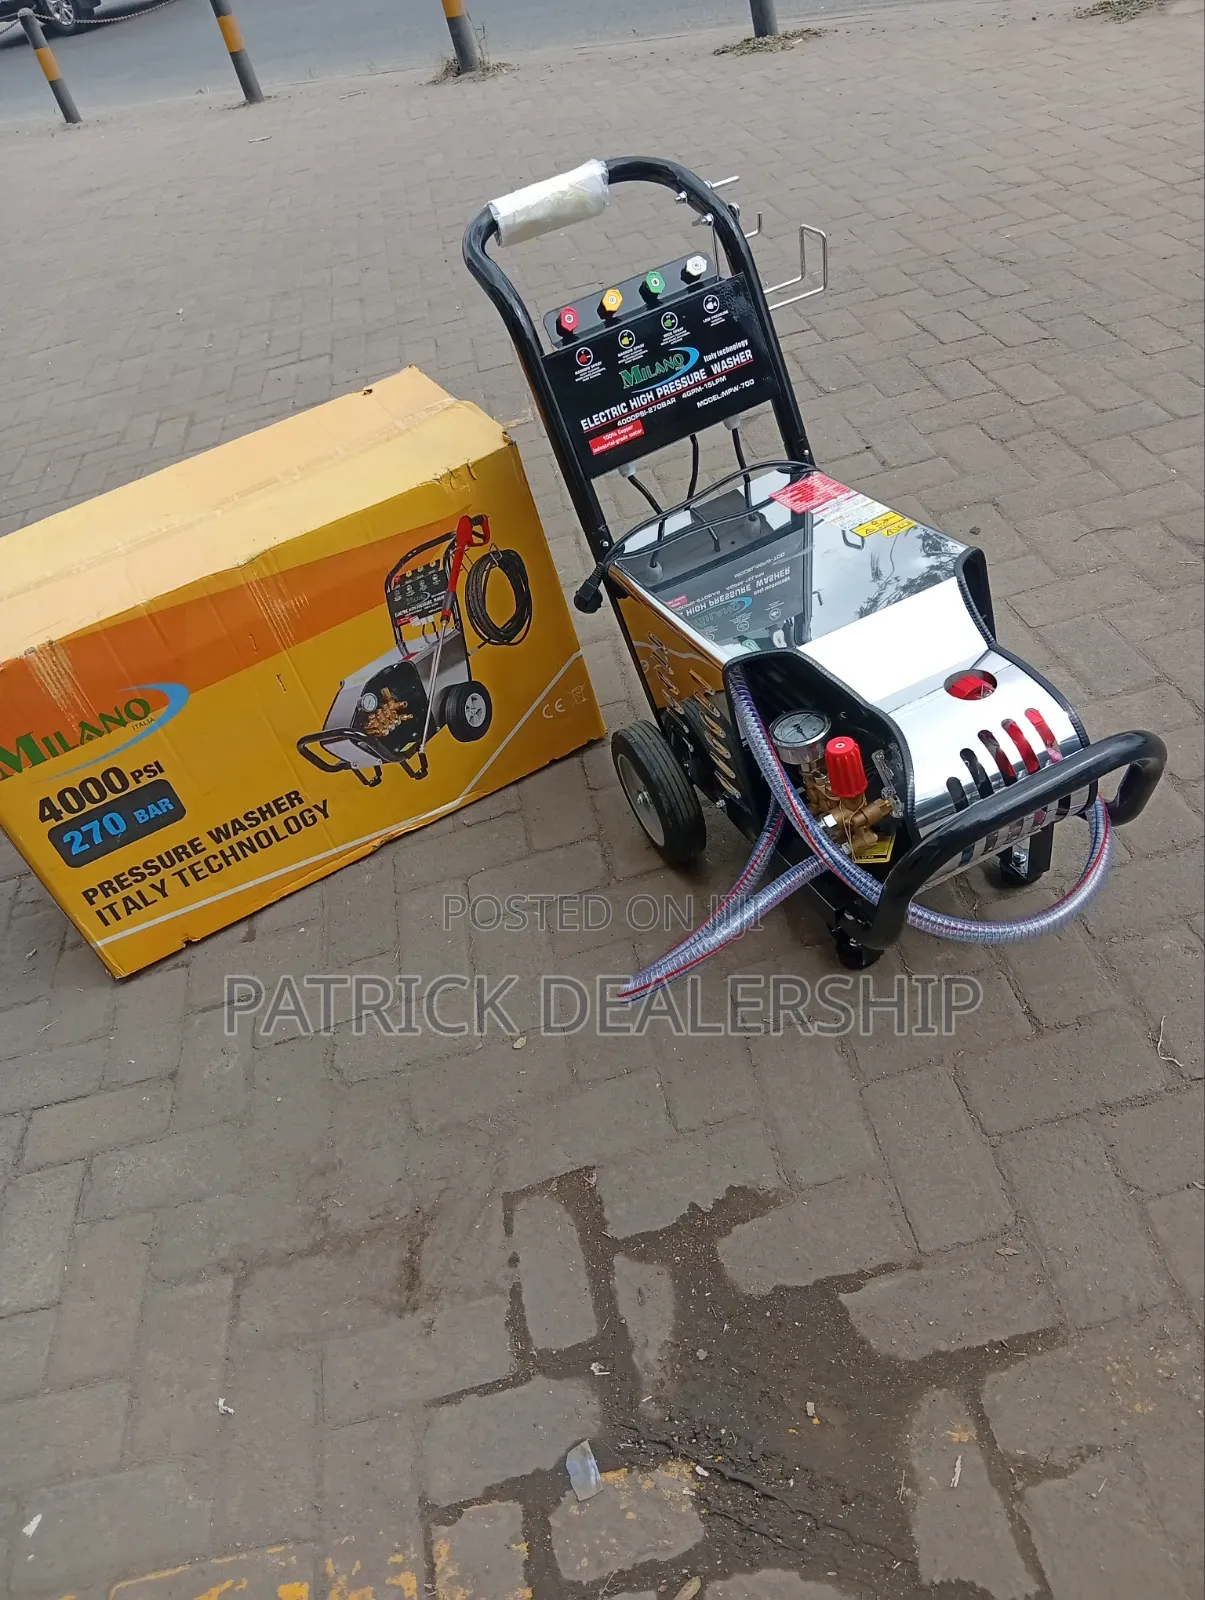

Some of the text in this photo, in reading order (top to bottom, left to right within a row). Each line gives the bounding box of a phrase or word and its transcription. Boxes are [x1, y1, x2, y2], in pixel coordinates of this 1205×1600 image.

[618, 353, 685, 389] MILANO
[703, 338, 748, 363] Italy technology
[580, 348, 753, 431] ELECTRIC HIGH PRESSURE WASHER
[616, 375, 727, 428] 4000PSI-270BAR 4GPM-15LPM
[696, 378, 755, 408] MODEL:MPW-700
[0, 697, 152, 782] MILANO
[132, 716, 156, 731] ITALIA
[38, 760, 166, 824] 4000 PSI
[62, 797, 175, 856] 270 BAR
[81, 789, 305, 906] PRESSURE WASHER
[95, 798, 330, 927] ITALY TECHNOLOGY
